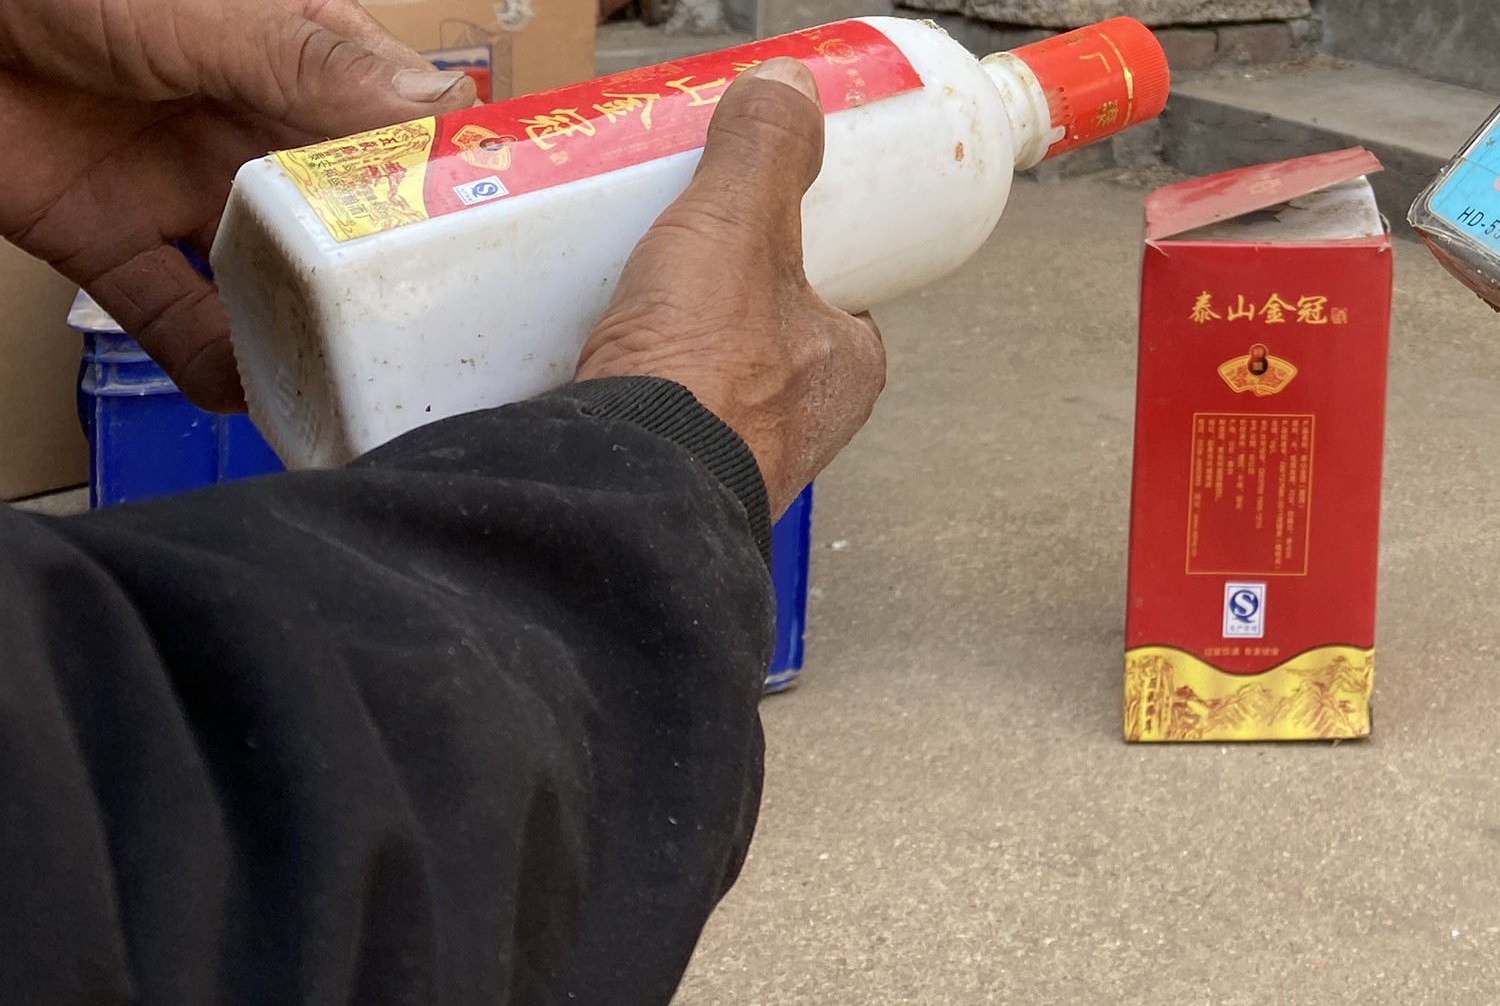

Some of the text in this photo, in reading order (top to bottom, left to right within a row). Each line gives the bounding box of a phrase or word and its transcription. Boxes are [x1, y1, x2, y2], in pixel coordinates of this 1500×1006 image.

[517, 60, 761, 151] 山金冠
[1188, 290, 1328, 325] 泰山金冠
